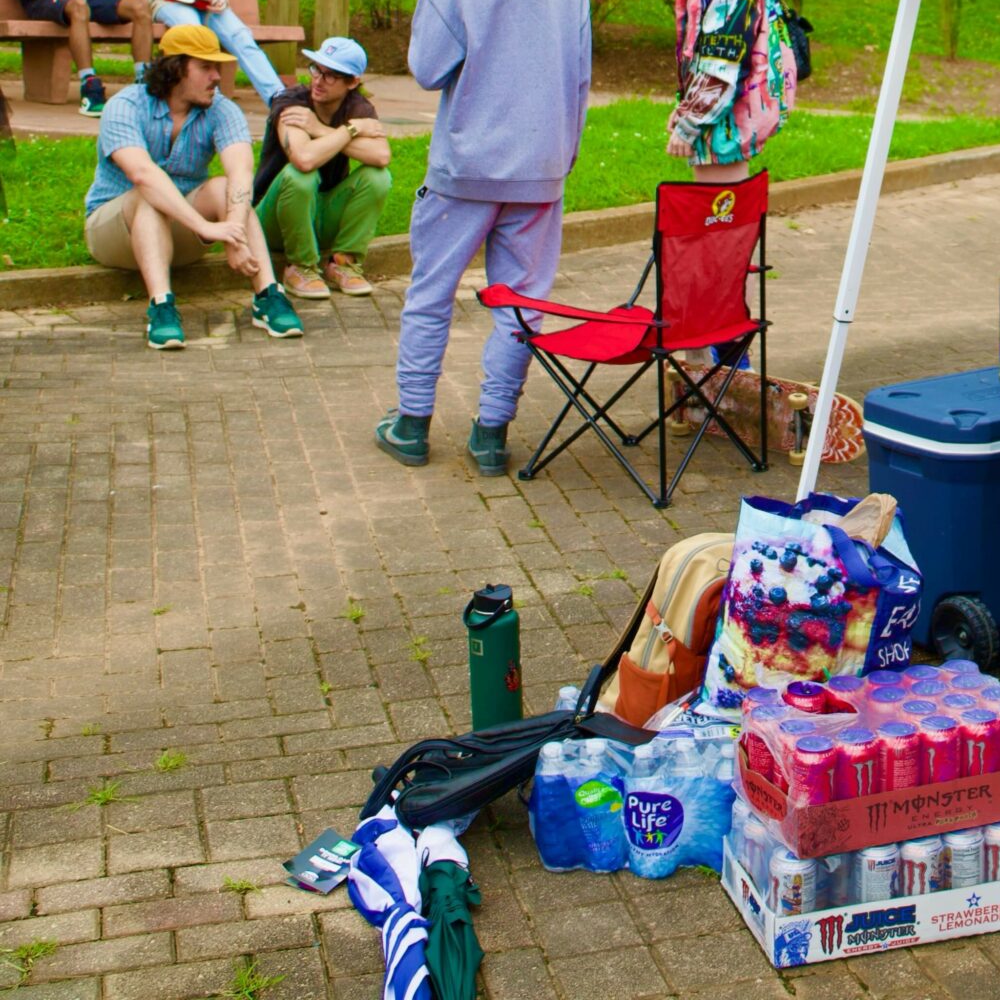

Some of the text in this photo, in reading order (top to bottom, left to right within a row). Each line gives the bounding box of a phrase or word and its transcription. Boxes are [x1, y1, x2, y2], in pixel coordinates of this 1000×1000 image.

[628, 796, 672, 813] Pure
[893, 784, 993, 815] MONSTER
[632, 812, 667, 831] Life
[844, 904, 916, 933] JUICE
[847, 925, 916, 945] MONSTER
